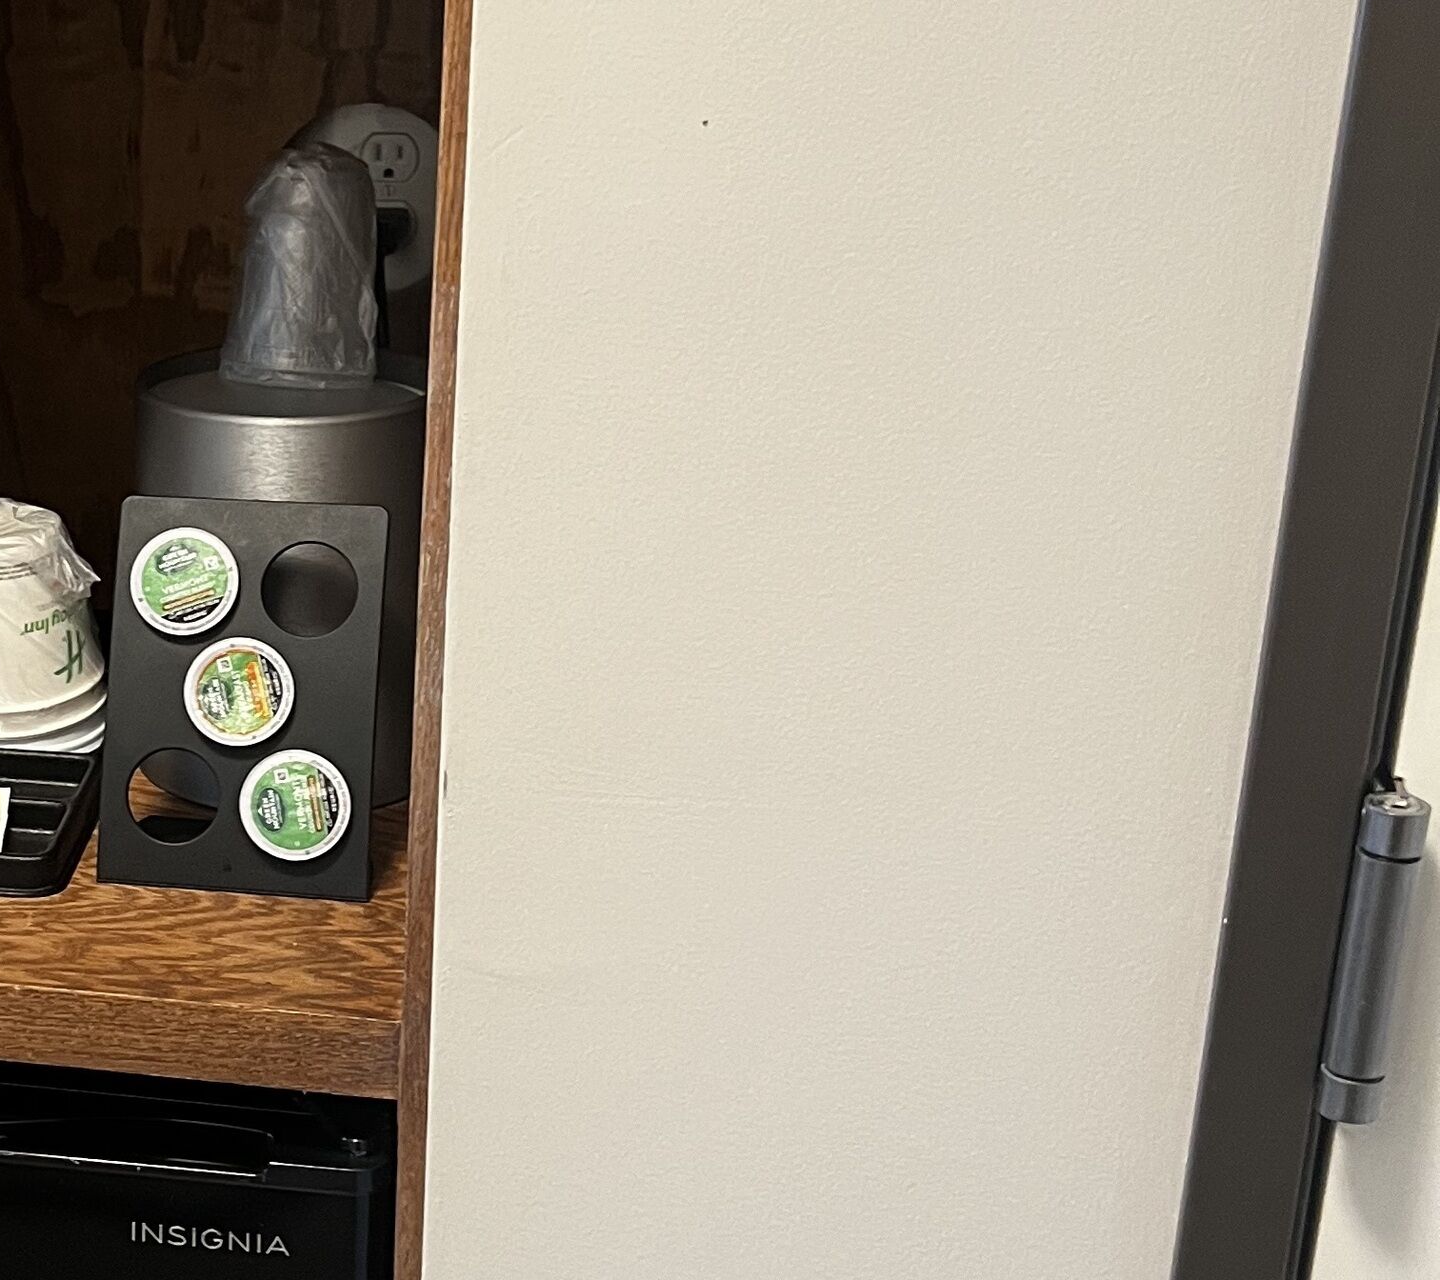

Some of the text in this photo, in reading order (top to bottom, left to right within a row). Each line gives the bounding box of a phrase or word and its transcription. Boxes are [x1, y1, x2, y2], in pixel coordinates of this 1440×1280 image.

[262, 798, 271, 824] GREEN
[267, 789, 280, 829] MOUNTAIN
[131, 1221, 290, 1257] INSIGNIA
